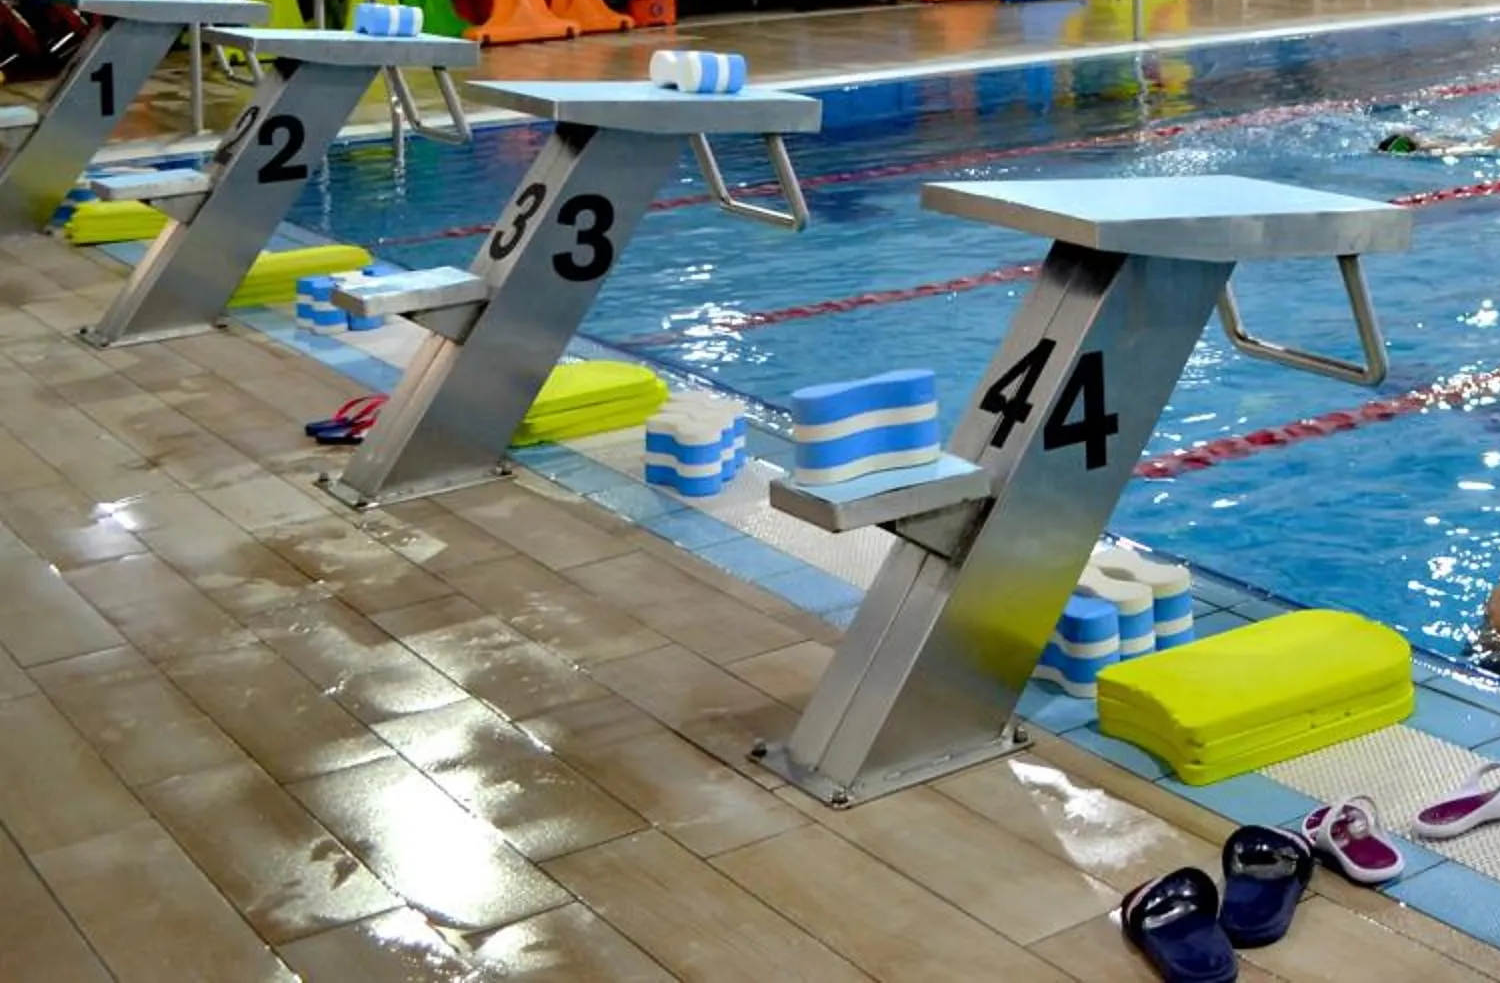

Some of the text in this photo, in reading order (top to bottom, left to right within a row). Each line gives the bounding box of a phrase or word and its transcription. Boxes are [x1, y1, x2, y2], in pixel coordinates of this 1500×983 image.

[90, 62, 114, 116] 1
[213, 105, 260, 165] 2
[257, 114, 308, 184] 2
[489, 182, 546, 261] 3
[552, 193, 614, 282] 3
[979, 337, 1057, 449] 4
[1043, 350, 1119, 471] 4
